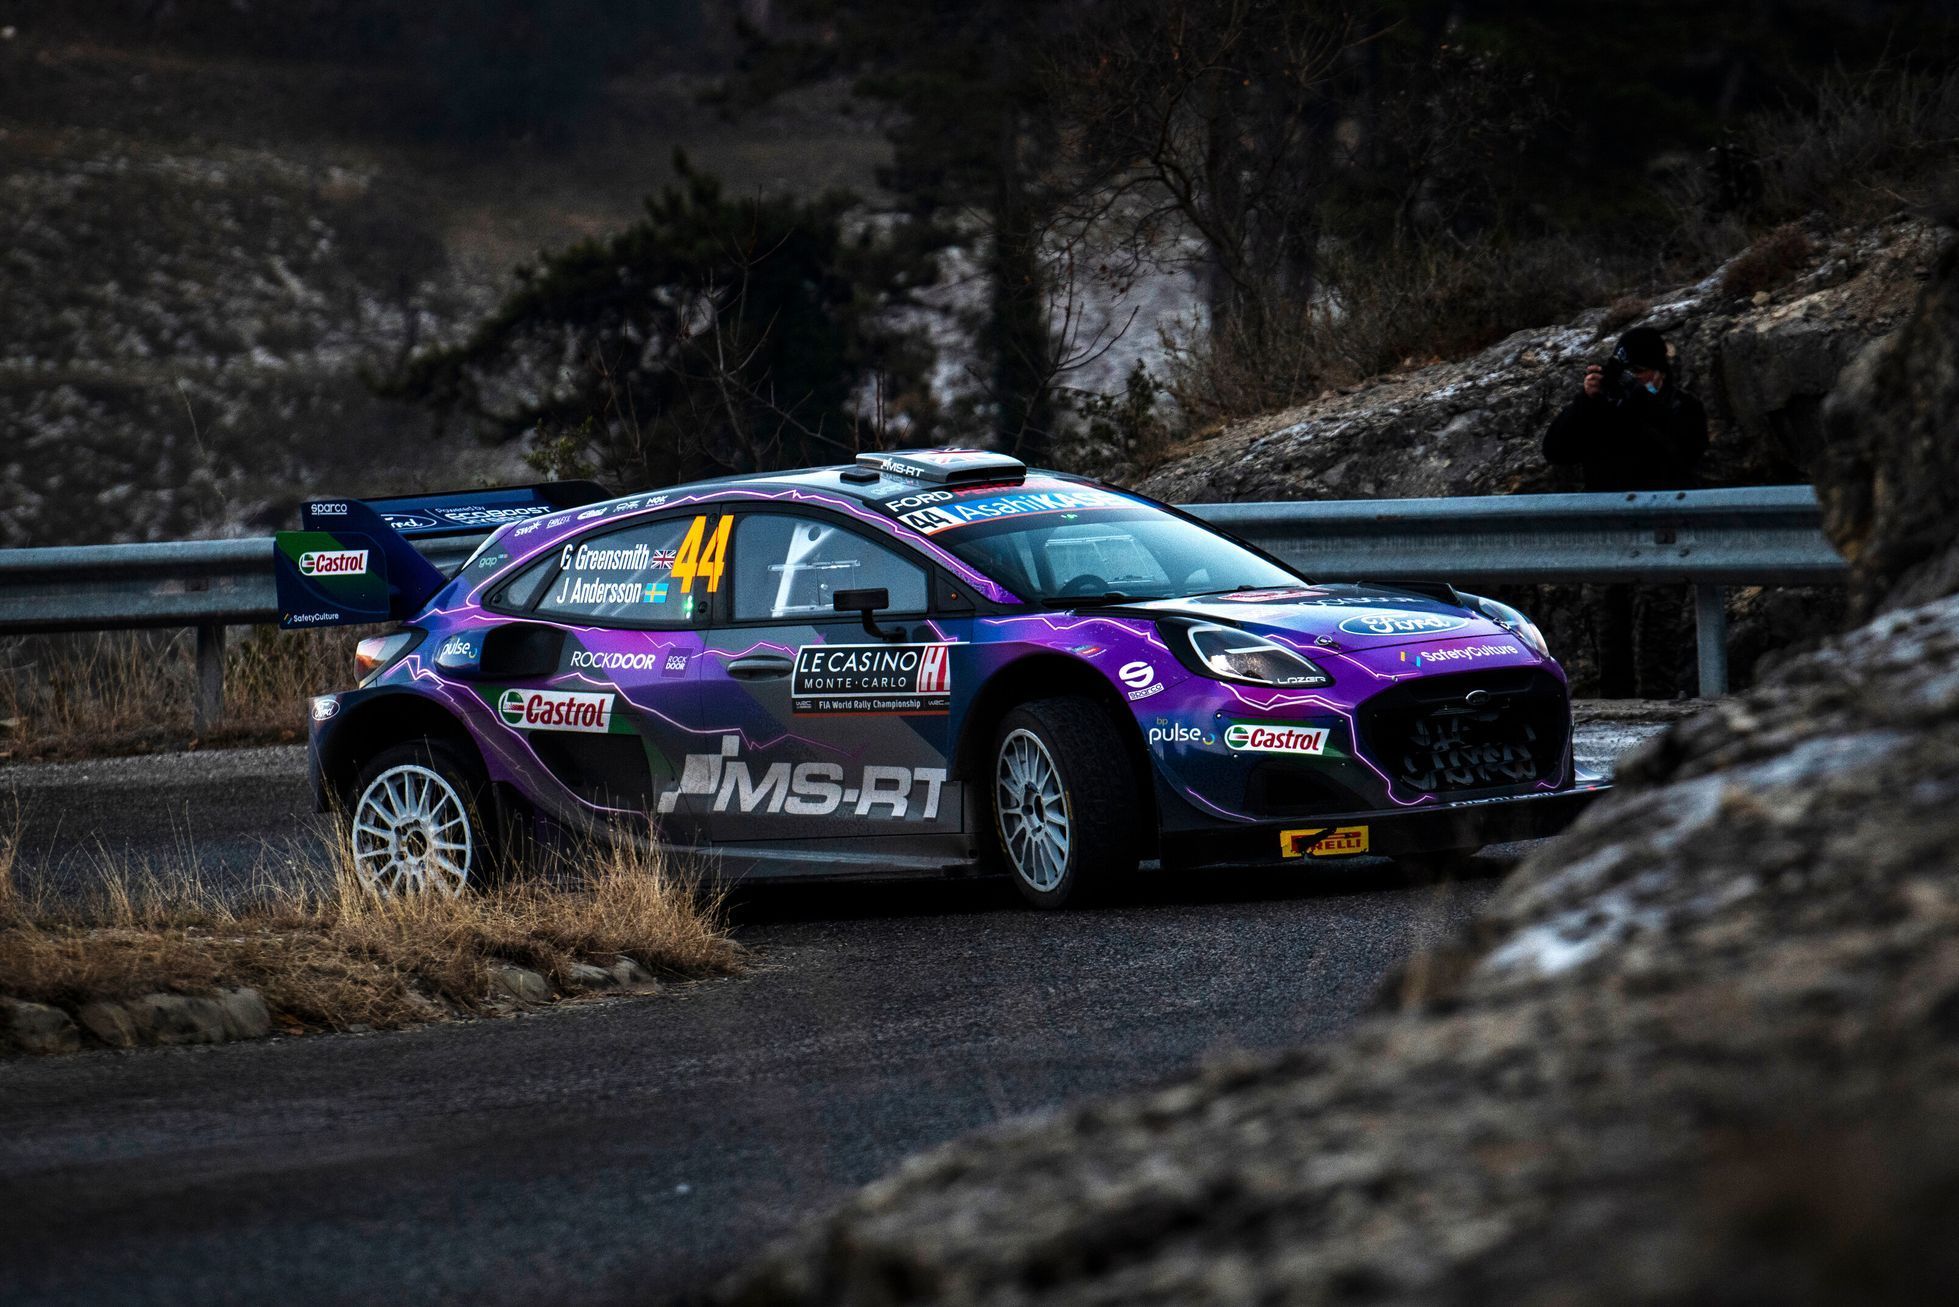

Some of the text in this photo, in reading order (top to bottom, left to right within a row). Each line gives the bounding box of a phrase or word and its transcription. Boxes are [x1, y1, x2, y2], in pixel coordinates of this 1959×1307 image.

[885, 461, 924, 477] MS-RT
[311, 503, 347, 515] sparco
[885, 491, 953, 512] FORD
[445, 506, 551, 521] ECOBOOST
[905, 510, 953, 529] 44
[316, 553, 364, 573] Castrol
[561, 544, 650, 570] G Greensmith
[670, 515, 734, 593] 44
[556, 577, 643, 604] J Andersson
[293, 612, 339, 622] SafetyCulture
[1360, 612, 1451, 634] Ford
[439, 637, 471, 660] pulse
[1420, 643, 1519, 663] SafetyCulture
[571, 651, 656, 670] ROCKDOOR
[665, 662, 685, 670] DOOR
[668, 655, 687, 663] ROCK
[800, 651, 918, 672] LE CASINO
[1129, 684, 1162, 699] sparco
[526, 694, 605, 727] Castrol
[818, 700, 831, 709] FIA
[832, 700, 852, 709] World
[853, 699, 871, 710] Rally
[872, 699, 921, 709] Championship
[1156, 717, 1168, 725] bp
[1149, 723, 1201, 744] pulse
[1250, 729, 1322, 750] Castrol
[712, 761, 947, 819] MS-RT
[1290, 834, 1361, 854] PRELLI
